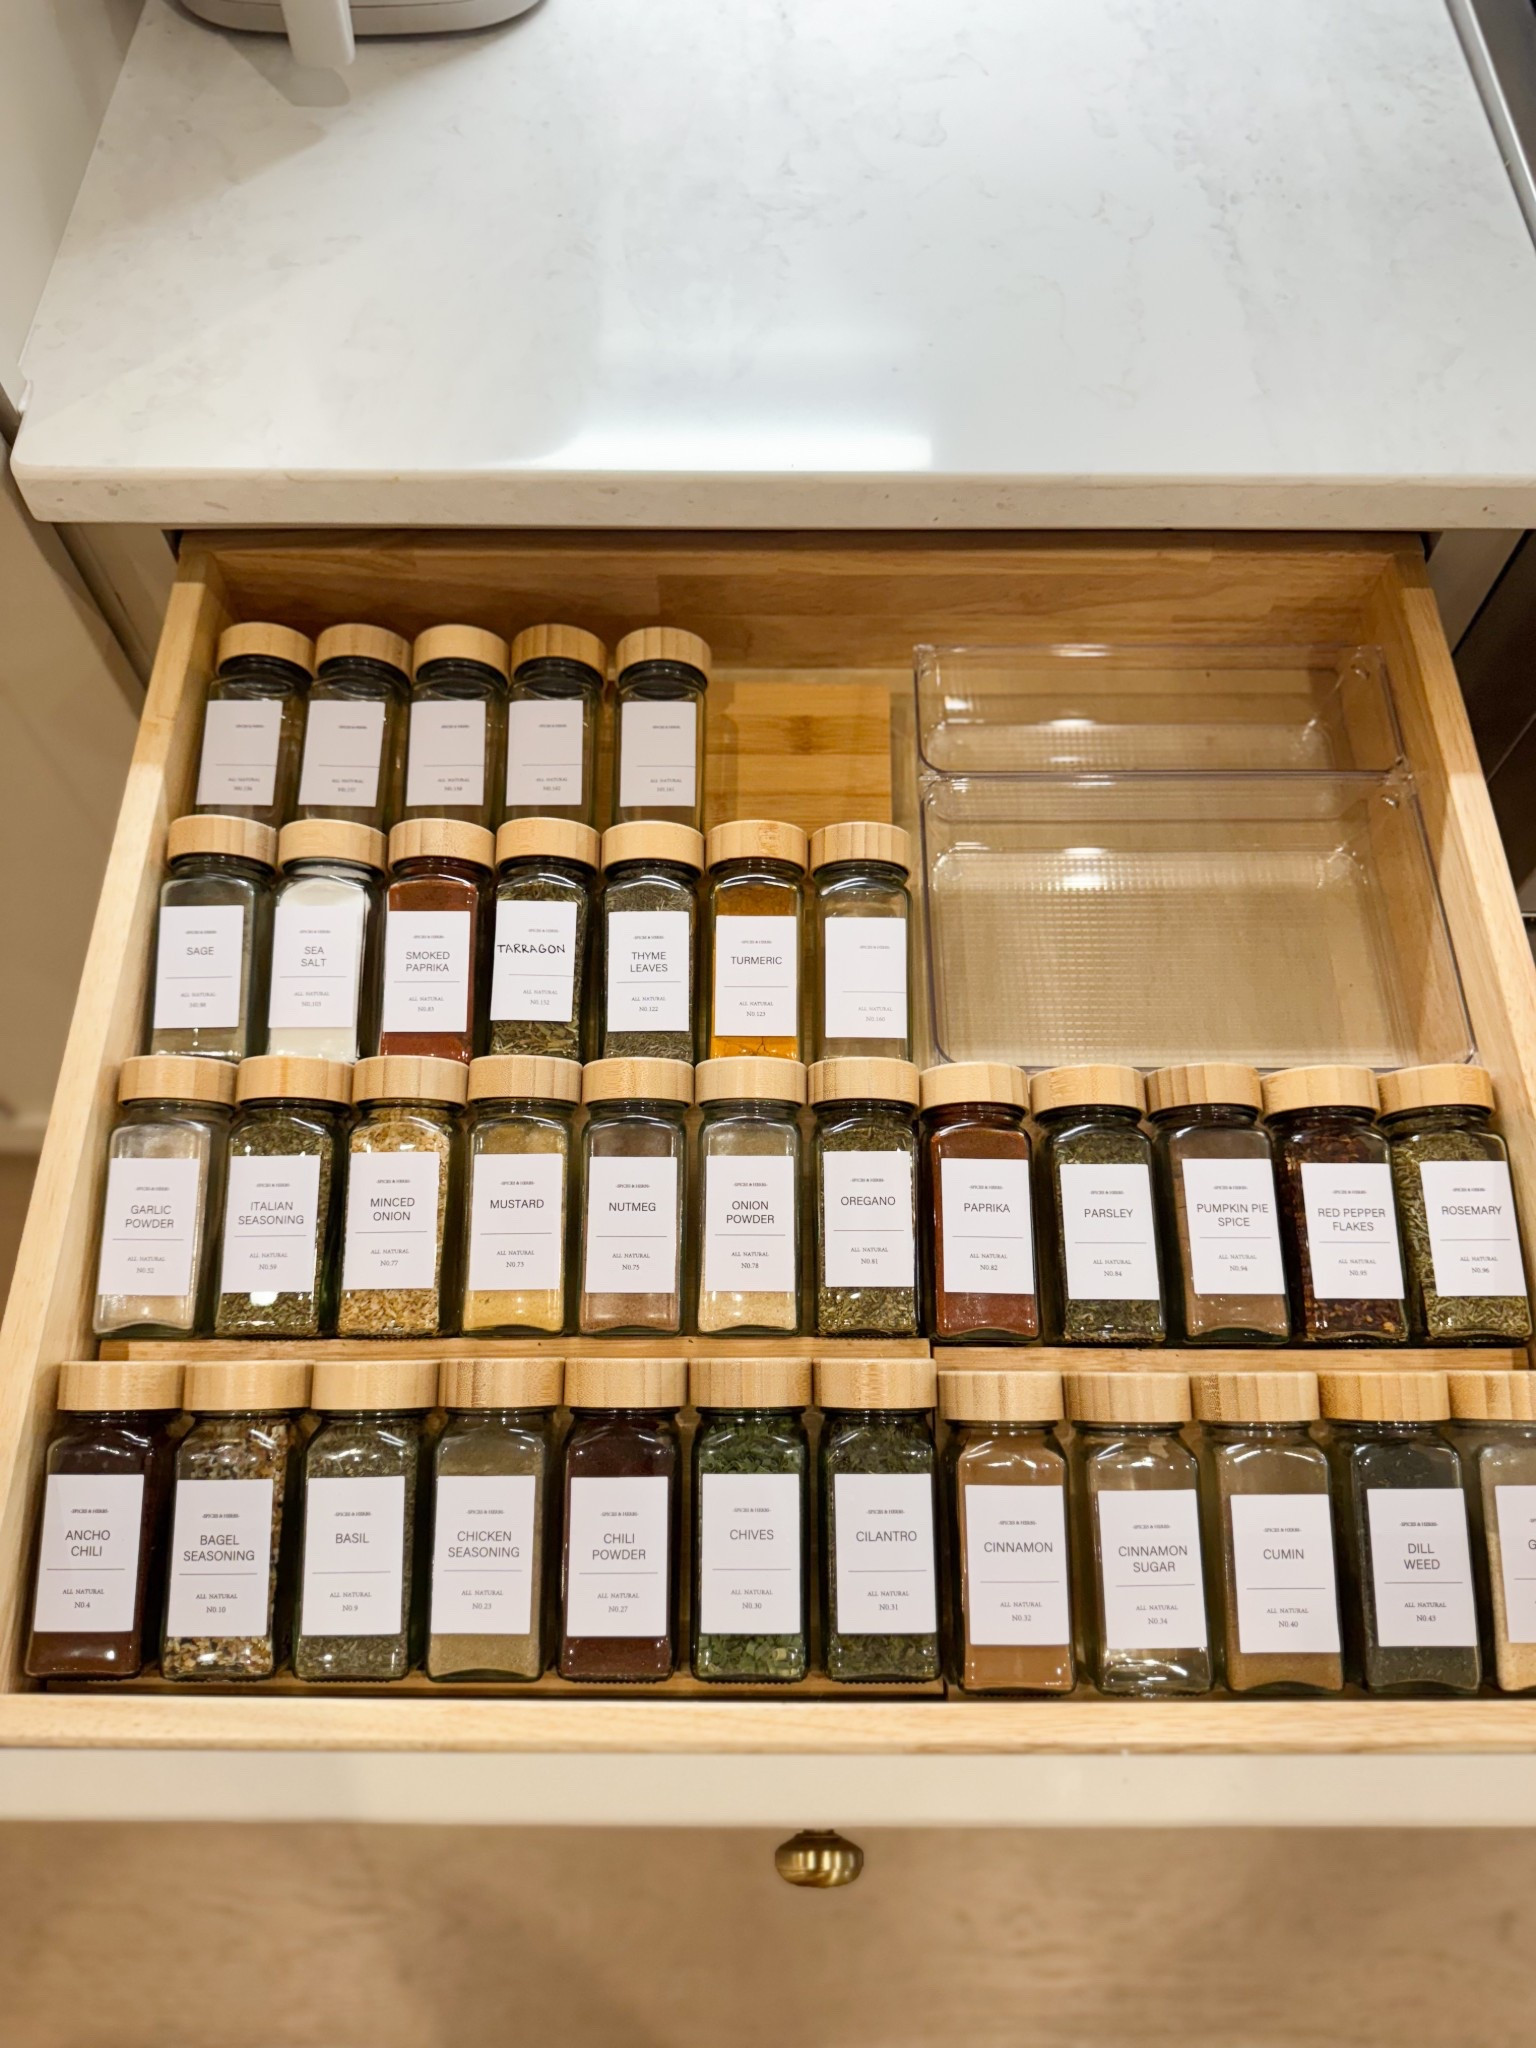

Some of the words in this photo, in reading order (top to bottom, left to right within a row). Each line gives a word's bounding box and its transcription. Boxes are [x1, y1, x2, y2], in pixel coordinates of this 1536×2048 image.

[185, 945, 215, 956] SAGE
[303, 945, 325, 956] SEA
[497, 943, 566, 955] TARRAGON
[404, 950, 451, 961] SMOKED
[631, 951, 667, 961] THYME
[729, 955, 783, 966] TURMERIC
[300, 957, 328, 968] SALT
[405, 962, 450, 973] PAPRIKA
[629, 962, 669, 974] LEAVES
[249, 1200, 294, 1212] ITALIAN
[369, 1196, 416, 1208] MINCED
[489, 1198, 545, 1210] MUSTARD
[608, 1201, 657, 1213] NUTMEG
[731, 1200, 769, 1212] ONION
[840, 1195, 897, 1207] OREGANO
[129, 1204, 172, 1216] GARLIC
[963, 1202, 1011, 1214] PAPRIKA
[1083, 1207, 1134, 1219] PARSLEY
[1196, 1202, 1249, 1214] PUMPKIN
[1251, 1202, 1270, 1214] PIE
[1317, 1207, 1341, 1219] RED
[1342, 1207, 1387, 1219] PEPPER
[1440, 1202, 1503, 1215] ROSEMARY
[237, 1214, 305, 1226] SEASONING
[372, 1210, 411, 1222] ONION
[725, 1213, 775, 1225] POWDER
[1217, 1216, 1252, 1228] SPICE
[124, 1217, 175, 1230] POWDER
[1332, 1220, 1375, 1232] FLAKES
[64, 1529, 111, 1542] ANCHO
[199, 1533, 241, 1547] BAGEL
[335, 1532, 370, 1545] BASIL
[456, 1529, 512, 1543] CHICKEN
[602, 1532, 635, 1546] CHILI
[729, 1528, 775, 1541] CHIVES
[855, 1529, 918, 1543] CILANTRO
[70, 1544, 103, 1558] CHILI
[447, 1545, 520, 1559] SEASONING
[983, 1541, 1054, 1554] CINNAMON
[1117, 1544, 1189, 1558] CINNAMON
[1407, 1542, 1436, 1555] DILL
[182, 1549, 256, 1563] SEASONING
[591, 1548, 647, 1561] POWDER
[1262, 1547, 1305, 1561] CUMIN
[1132, 1560, 1176, 1574] SUGAR
[1403, 1558, 1441, 1571] WEED
[729, 1588, 742, 1596] ALL
[743, 1588, 774, 1596] NATURAL
[1403, 1601, 1416, 1609] ALL
[1417, 1601, 1448, 1609] NATURAL
